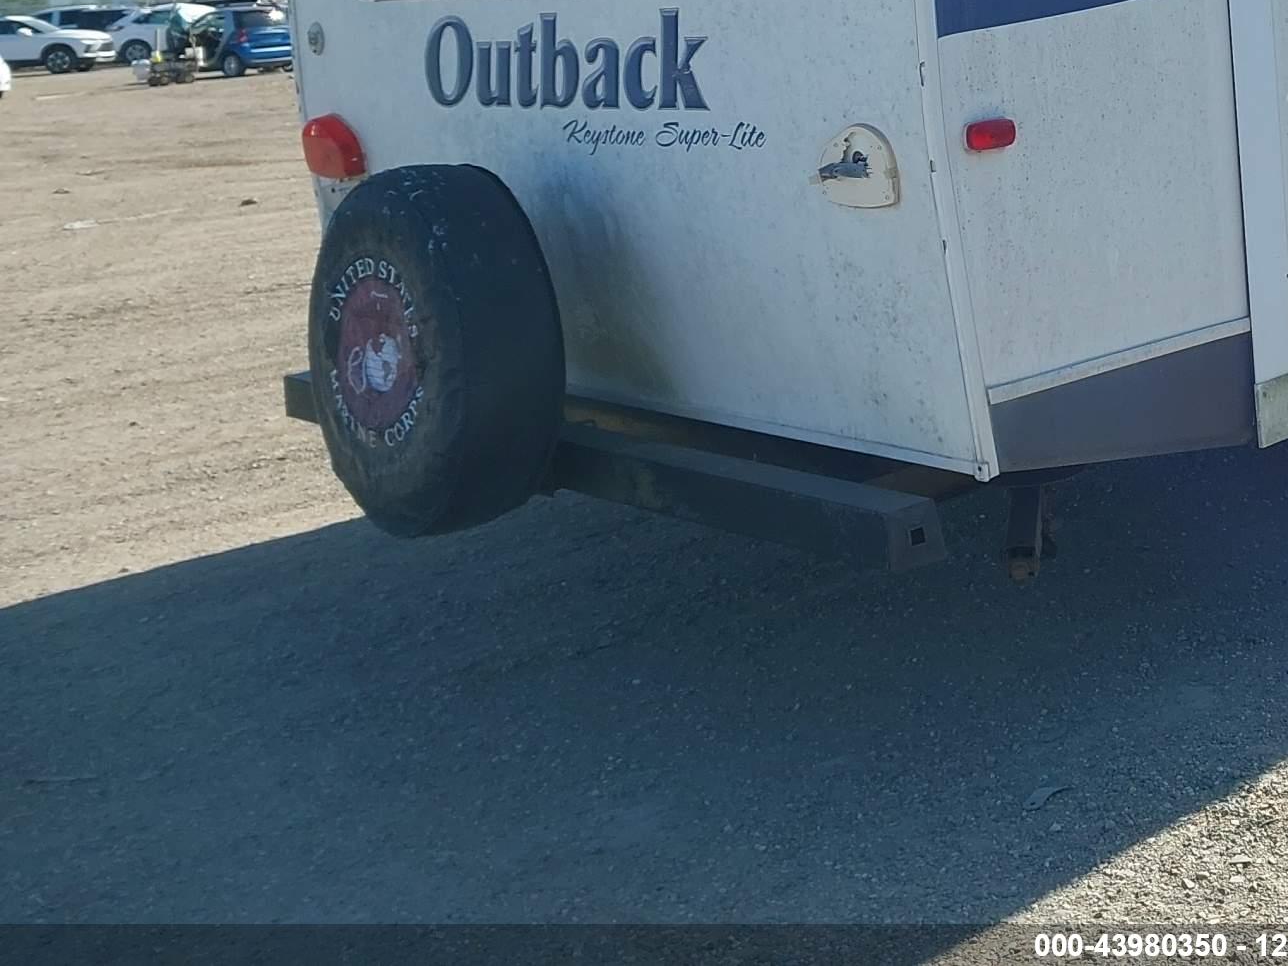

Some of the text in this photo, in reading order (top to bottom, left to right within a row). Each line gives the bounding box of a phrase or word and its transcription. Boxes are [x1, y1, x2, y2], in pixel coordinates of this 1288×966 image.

[424, 7, 711, 111] Outback
[562, 119, 766, 156] Keystone Super-Lite
[329, 257, 374, 322] UNITED
[384, 386, 424, 447] CORPS
